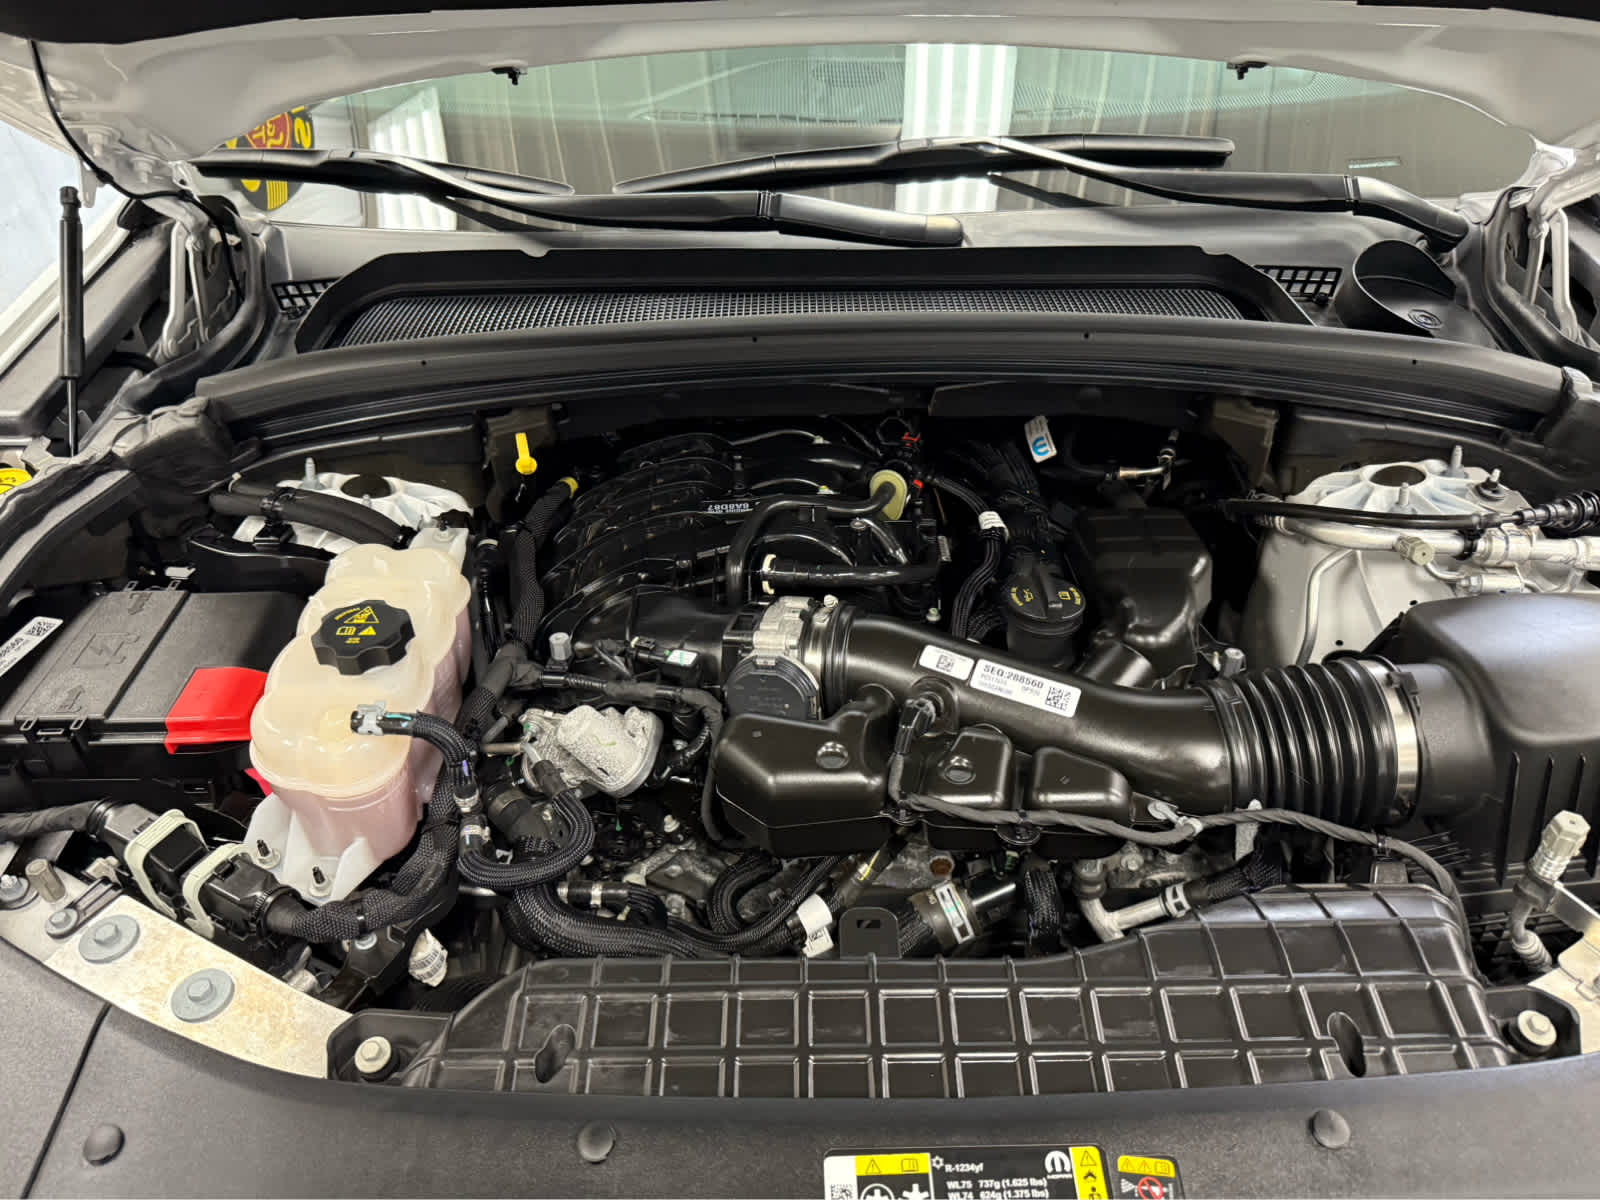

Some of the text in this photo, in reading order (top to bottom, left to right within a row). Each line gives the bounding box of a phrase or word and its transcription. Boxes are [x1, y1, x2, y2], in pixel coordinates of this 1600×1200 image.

[983, 664, 1044, 690] SEQ:288560
[944, 1162, 984, 1174] R-1234yf
[946, 1177, 1048, 1190] WL75 737g (1.625 lbs)
[947, 1191, 975, 1200] WL74
[1002, 1189, 1031, 1200] (1.375
[1031, 1188, 1050, 1199] lbs)
